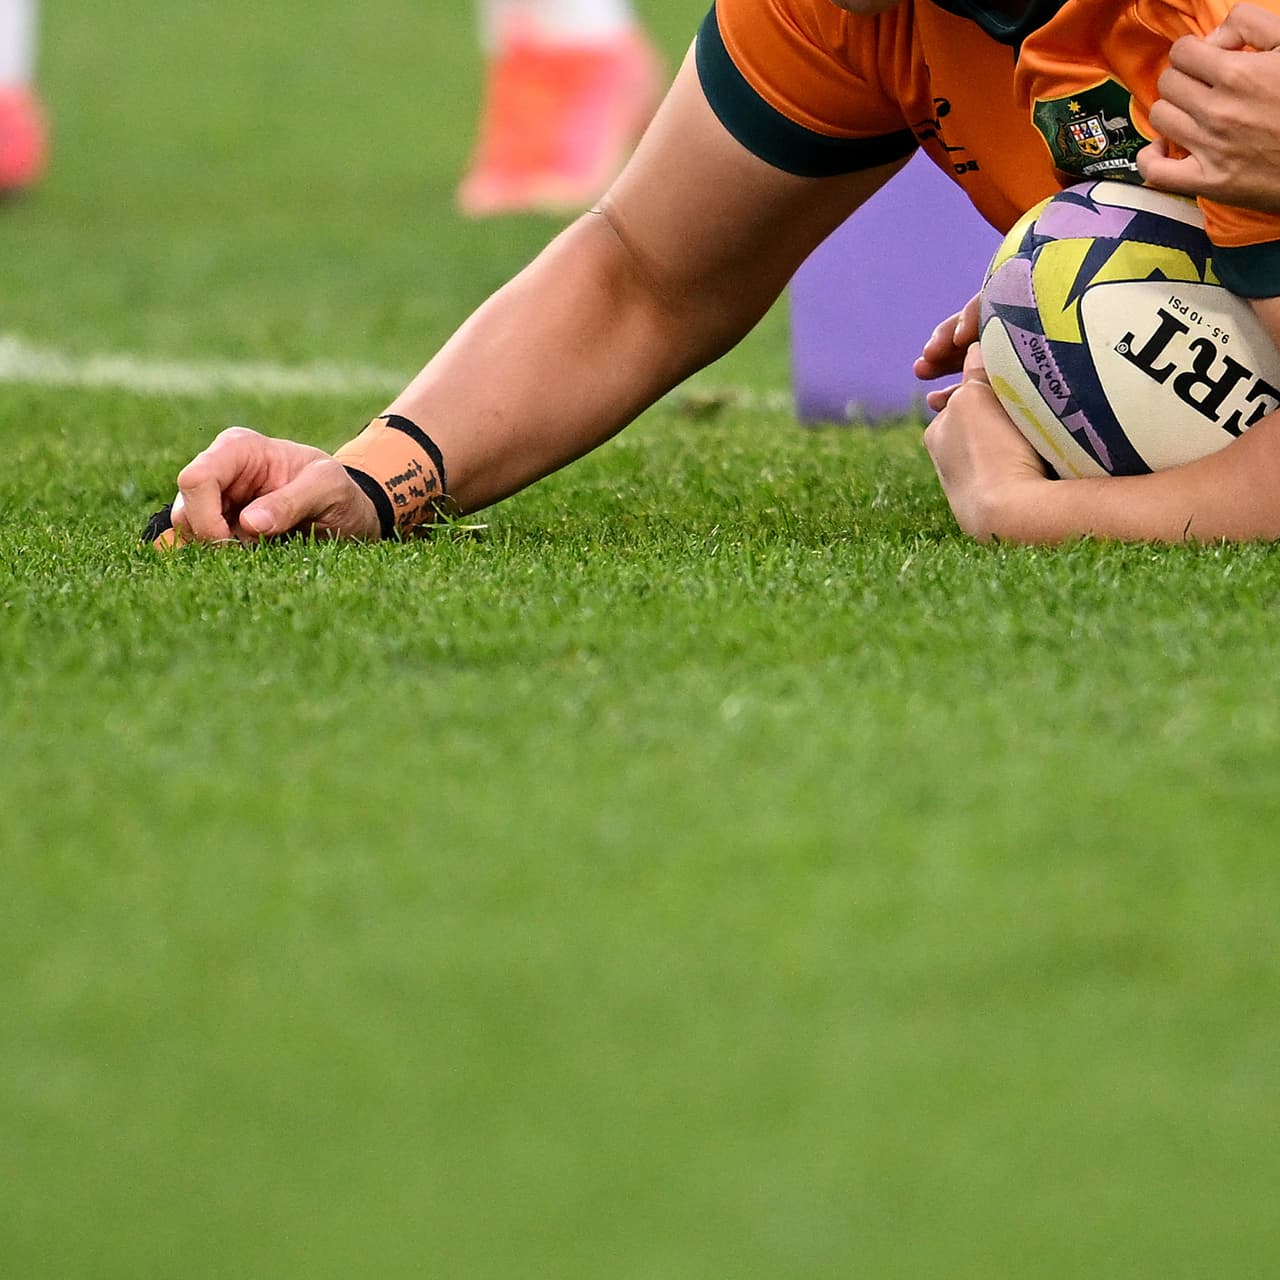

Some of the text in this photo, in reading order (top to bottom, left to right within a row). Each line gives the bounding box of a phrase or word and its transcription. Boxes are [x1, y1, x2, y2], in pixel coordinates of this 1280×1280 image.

[1168, 295, 1190, 315] PSI
[1190, 310, 1204, 325] 10
[1211, 326, 1230, 345] 9.5
